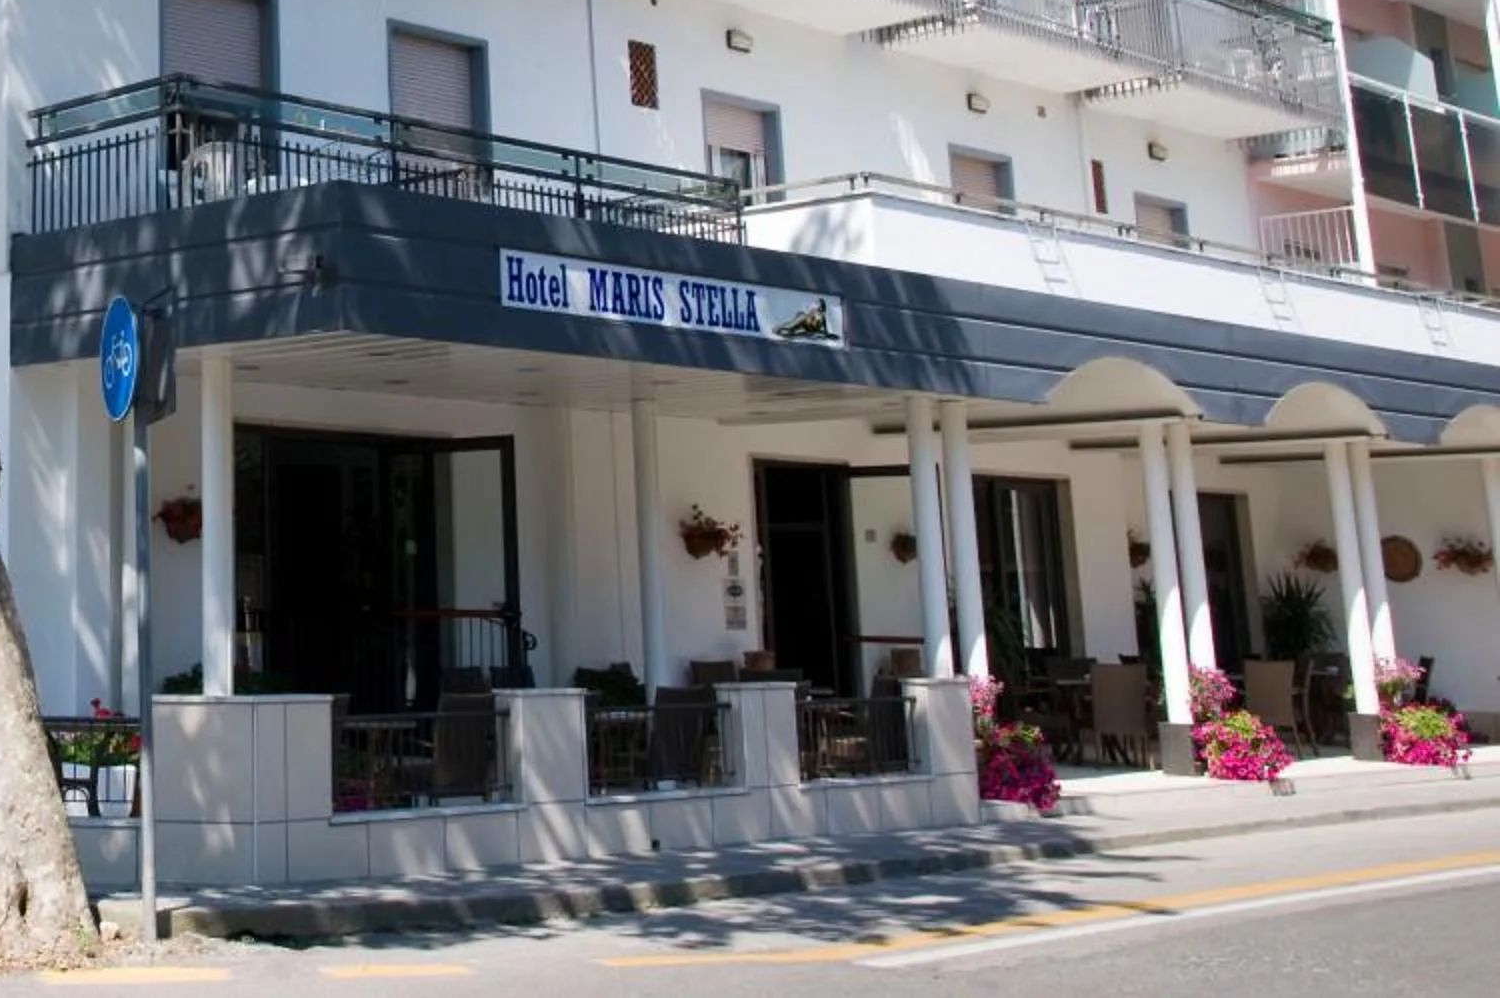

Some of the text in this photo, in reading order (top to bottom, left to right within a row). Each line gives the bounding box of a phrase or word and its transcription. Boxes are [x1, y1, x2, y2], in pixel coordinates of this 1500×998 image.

[506, 255, 760, 332] Hotel MARIS STELLA
